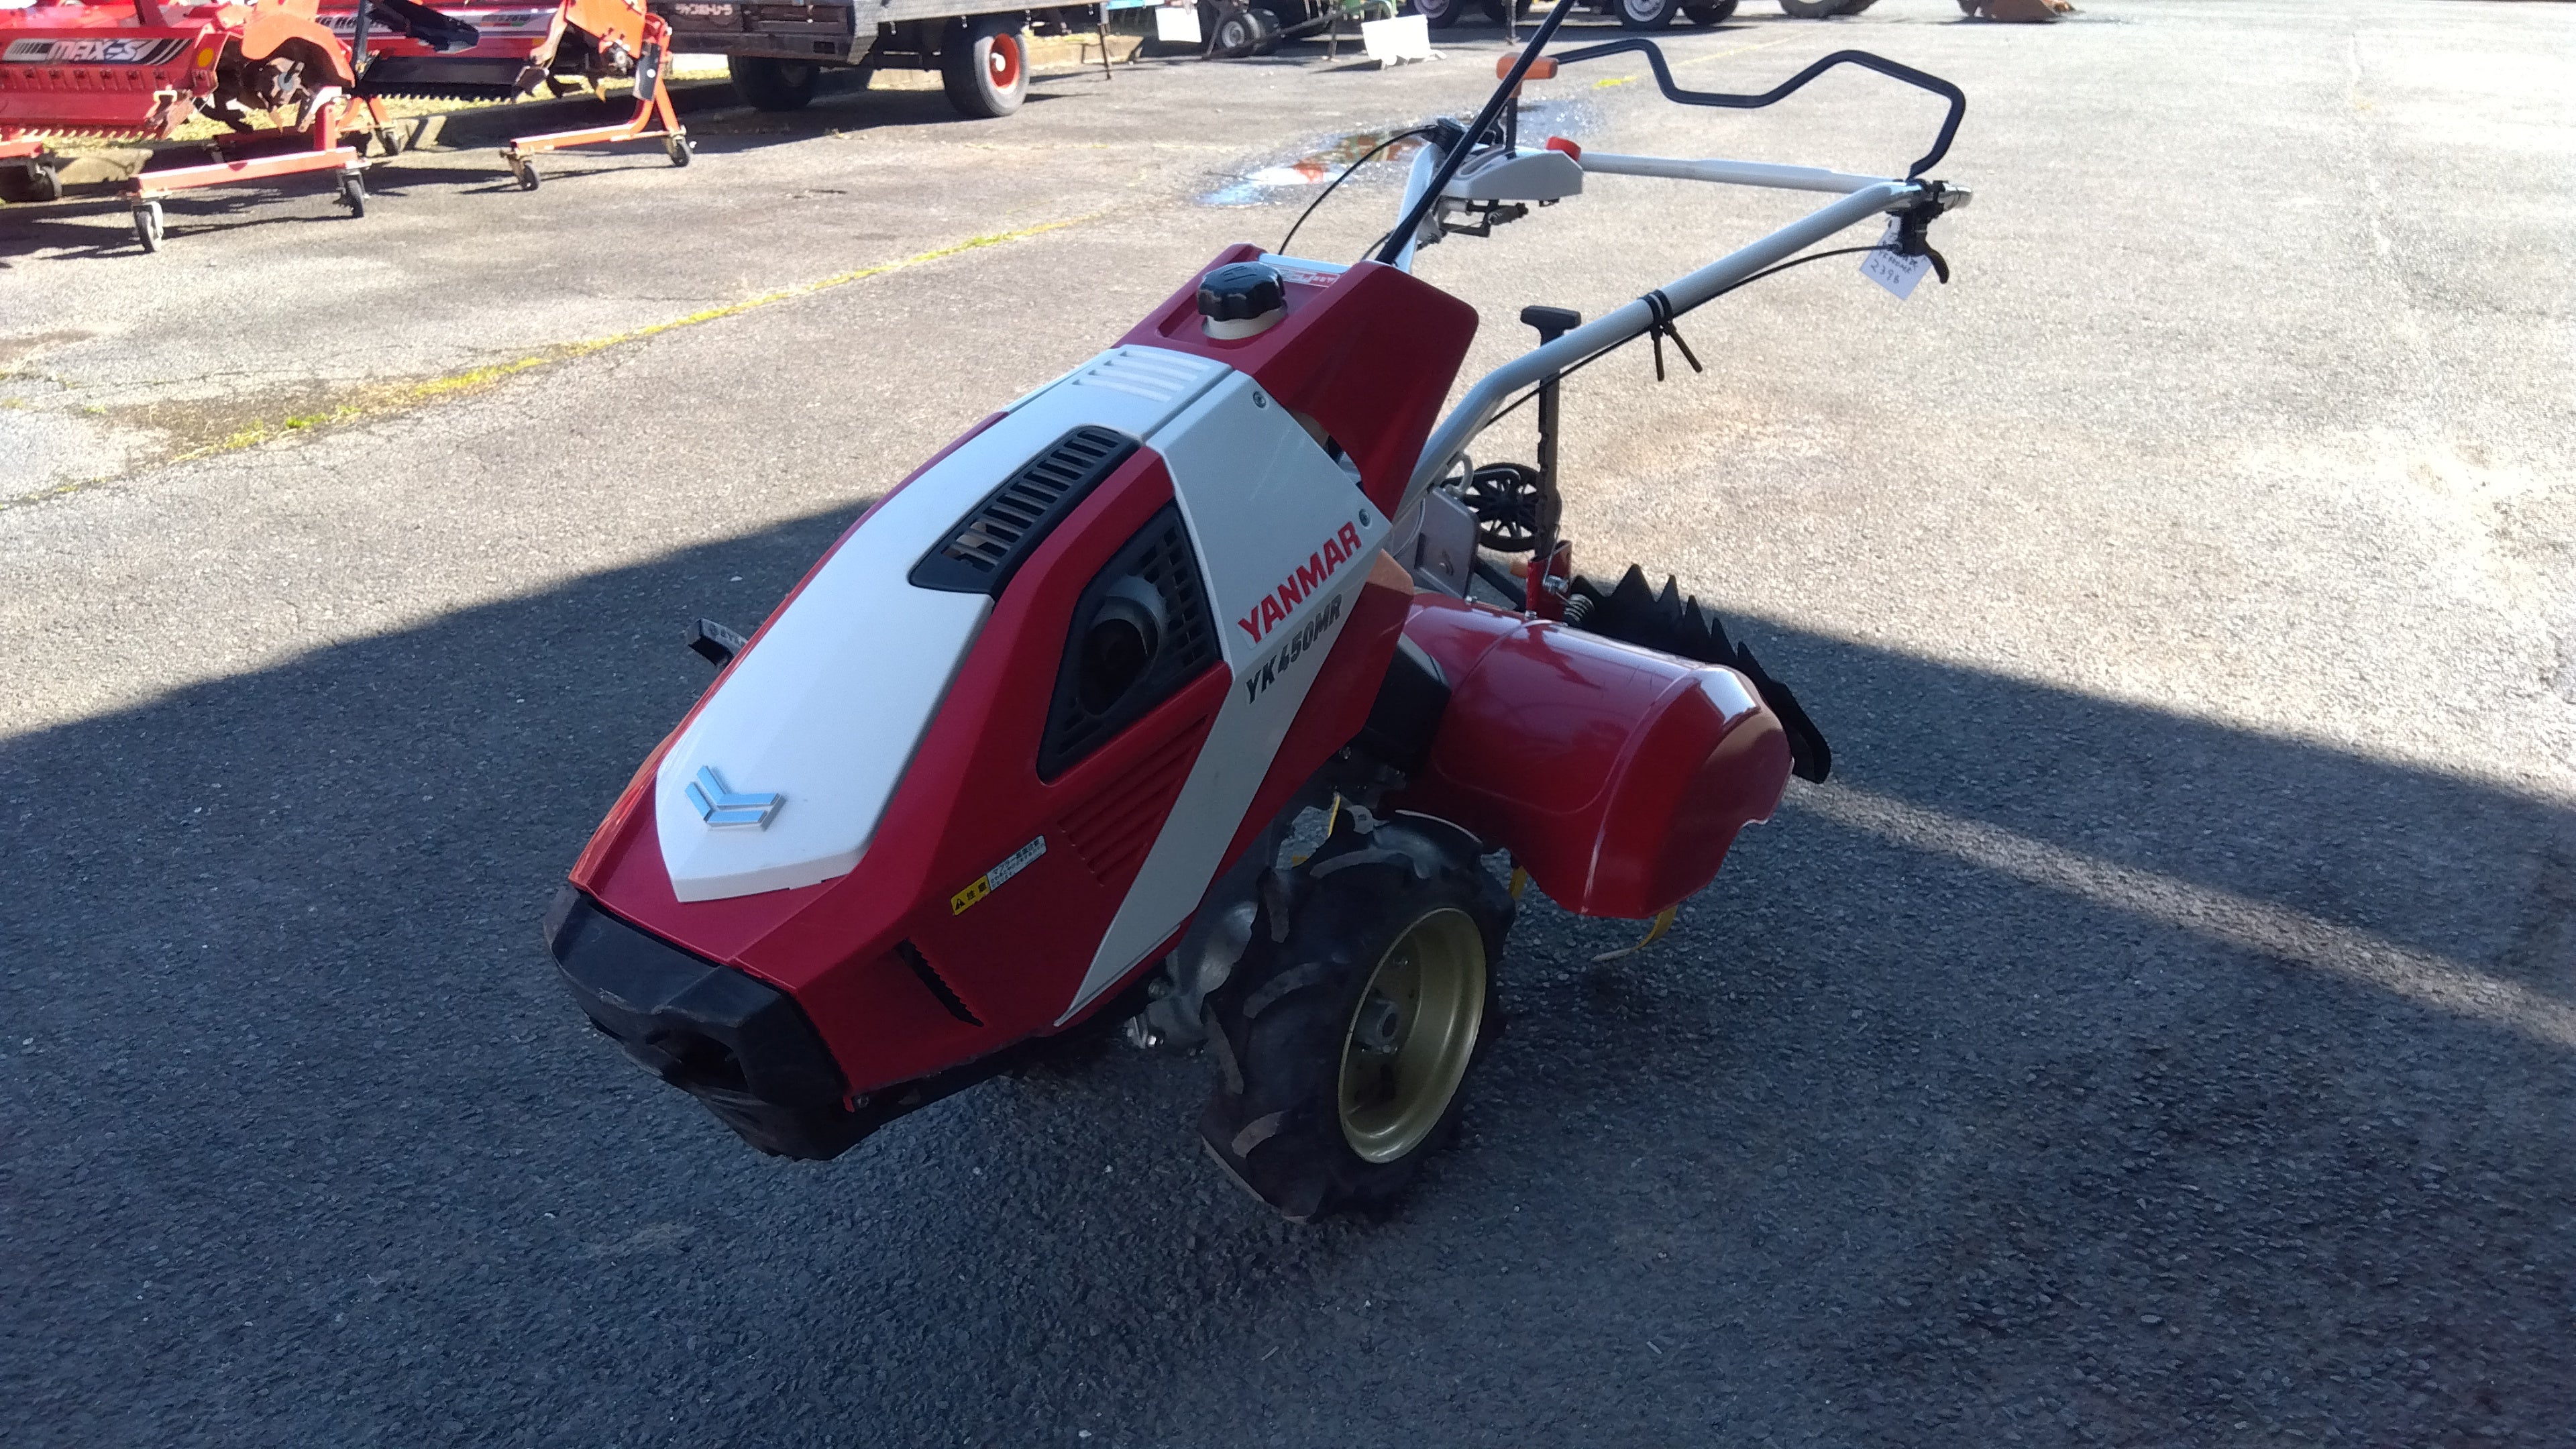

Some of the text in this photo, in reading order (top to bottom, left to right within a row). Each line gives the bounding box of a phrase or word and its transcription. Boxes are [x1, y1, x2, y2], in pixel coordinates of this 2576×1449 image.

[46, 39, 137, 61] MAX-S
[1238, 521, 1361, 644] YANMAR
[967, 881, 987, 900] 注意
